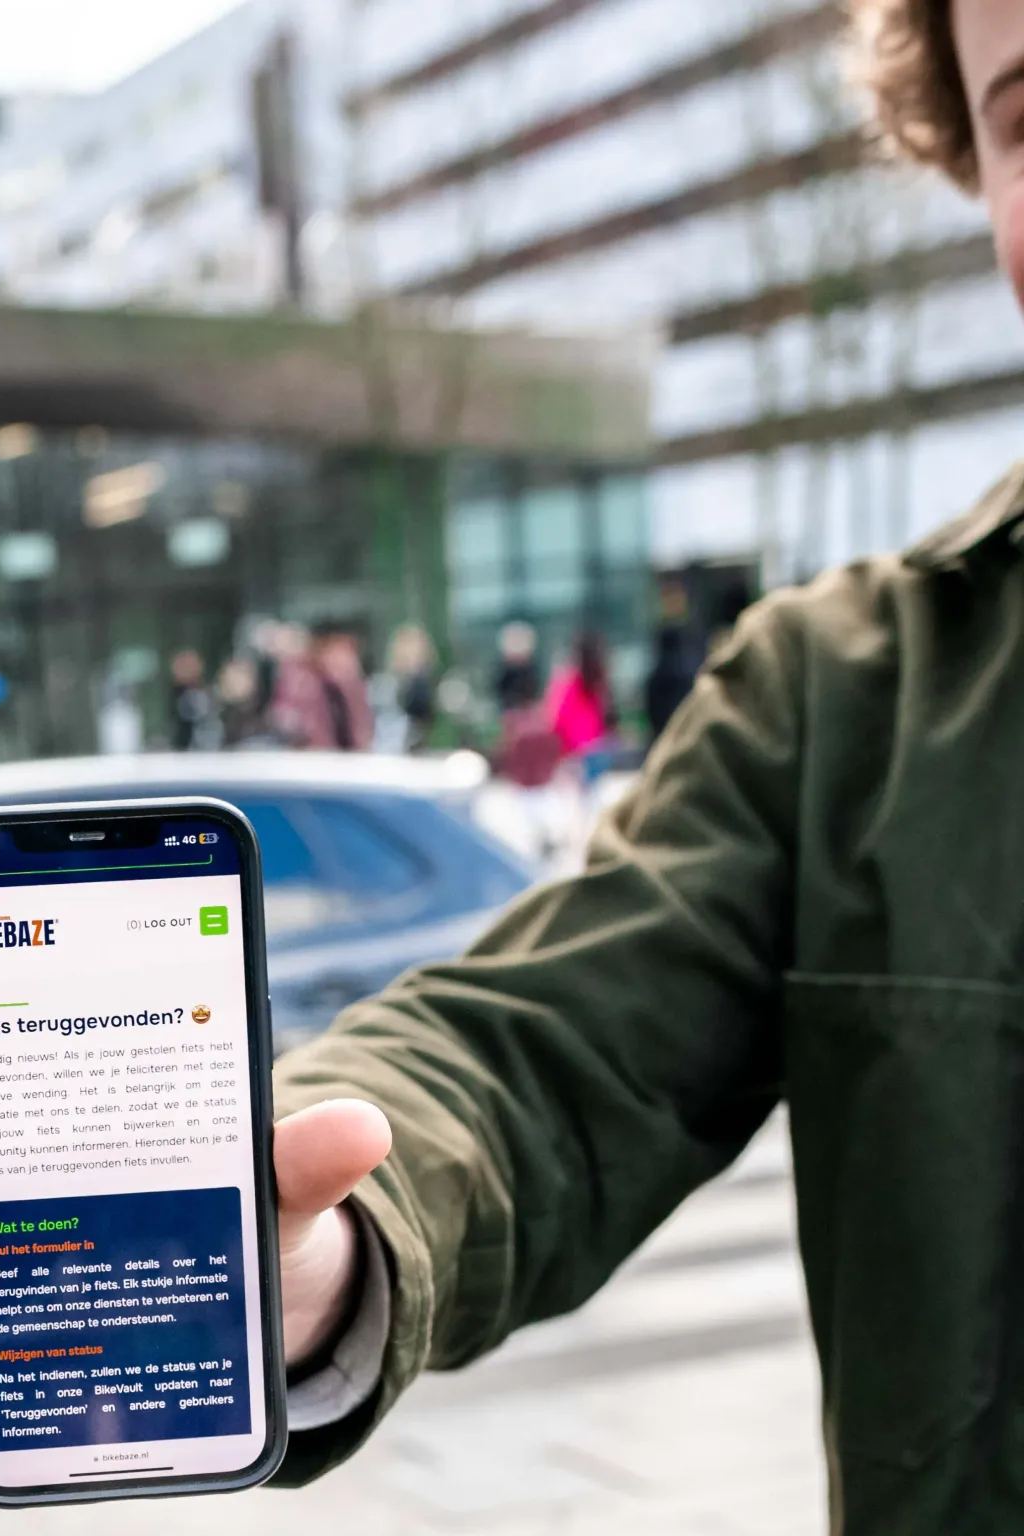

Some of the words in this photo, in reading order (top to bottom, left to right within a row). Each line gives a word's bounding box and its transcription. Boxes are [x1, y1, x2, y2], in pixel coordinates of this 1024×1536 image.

[182, 836, 197, 845] 4G
[203, 835, 215, 844] 25
[127, 920, 142, 932] (0)
[145, 920, 167, 929] LOG
[171, 918, 193, 928] OUT
[17, 1008, 184, 1036] teruggevonden?
[17, 1051, 58, 1063] nieuws!
[64, 1050, 80, 1059] Als
[85, 1051, 94, 1061] je
[99, 1049, 125, 1060] jouw
[130, 1045, 176, 1059] gestolen
[181, 1044, 205, 1052] fiets
[210, 1042, 233, 1051] hebt
[53, 1069, 83, 1079] willen
[89, 1069, 105, 1077] we
[111, 1068, 120, 1078] je
[126, 1064, 178, 1075] feliciteren
[183, 1062, 203, 1071] met
[210, 1061, 235, 1070] deze
[79, 1087, 98, 1096] Het
[125, 1082, 176, 1094] belangrijk
[210, 1080, 236, 1088] deze
[24, 1108, 44, 1118] met
[50, 1108, 70, 1116] ons
[75, 1106, 86, 1115] te
[128, 1101, 158, 1112] zodat
[163, 1101, 179, 1109] we
[185, 1100, 198, 1108] de
[204, 1098, 236, 1107] status
[37, 1126, 60, 1135] fiets
[72, 1124, 111, 1133] kunnen
[123, 1119, 175, 1132] bijwerken
[186, 1118, 200, 1127] en
[212, 1116, 237, 1125] onze
[29, 1145, 69, 1154] kunnen
[72, 1141, 131, 1152] informeren.
[135, 1137, 186, 1148] Hieronder
[190, 1136, 209, 1144] kun
[212, 1136, 222, 1145] je
[225, 1133, 238, 1142] de
[7, 1166, 26, 1174] van
[28, 1164, 38, 1175] je
[41, 1159, 122, 1174] teruggevonden
[124, 1157, 147, 1166] fiets
[150, 1155, 192, 1165] invullen.
[20, 1221, 35, 1232] te
[38, 1217, 79, 1231] doen?
[11, 1245, 30, 1255] het
[32, 1241, 82, 1253] formulier
[84, 1240, 94, 1250] in
[31, 1266, 50, 1277] alle
[62, 1262, 112, 1274] relevante
[124, 1259, 160, 1271] details
[172, 1258, 196, 1268] over
[209, 1255, 227, 1265] het
[59, 1284, 79, 1293] van
[81, 1281, 92, 1294] je
[94, 1280, 121, 1291] fiets.
[123, 1278, 139, 1289] Elk
[141, 1276, 173, 1288] stukje
[175, 1273, 228, 1285] informatie
[24, 1304, 44, 1314] ons
[46, 1303, 63, 1312] om
[65, 1301, 91, 1311] onze
[93, 1297, 140, 1309] diensten
[141, 1296, 153, 1306] te
[155, 1293, 213, 1305] verbeteren
[215, 1292, 229, 1301] en
[12, 1319, 86, 1335] gemeenschap
[87, 1318, 99, 1327] te
[101, 1314, 177, 1327] ondersteunen.
[46, 1349, 66, 1357] van
[68, 1345, 103, 1356] status
[0, 1373, 14, 1384] Na
[17, 1372, 36, 1382] het
[39, 1369, 88, 1381] indienen,
[90, 1366, 122, 1378] zullen
[124, 1366, 141, 1375] we
[145, 1364, 159, 1374] de
[162, 1361, 196, 1372] status
[199, 1361, 219, 1370] van
[222, 1358, 232, 1370] je
[0, 1391, 24, 1402] fiets
[35, 1389, 45, 1399] in
[56, 1388, 83, 1398] onze
[94, 1382, 144, 1395] BikeVault
[154, 1379, 198, 1393] updaten
[209, 1378, 234, 1387] naar
[102, 1404, 116, 1412] en
[129, 1400, 166, 1411] andere
[179, 1395, 234, 1410] gebruikers
[2, 1426, 62, 1438] informeren.
[103, 1452, 149, 1462] bikebaze.nl
